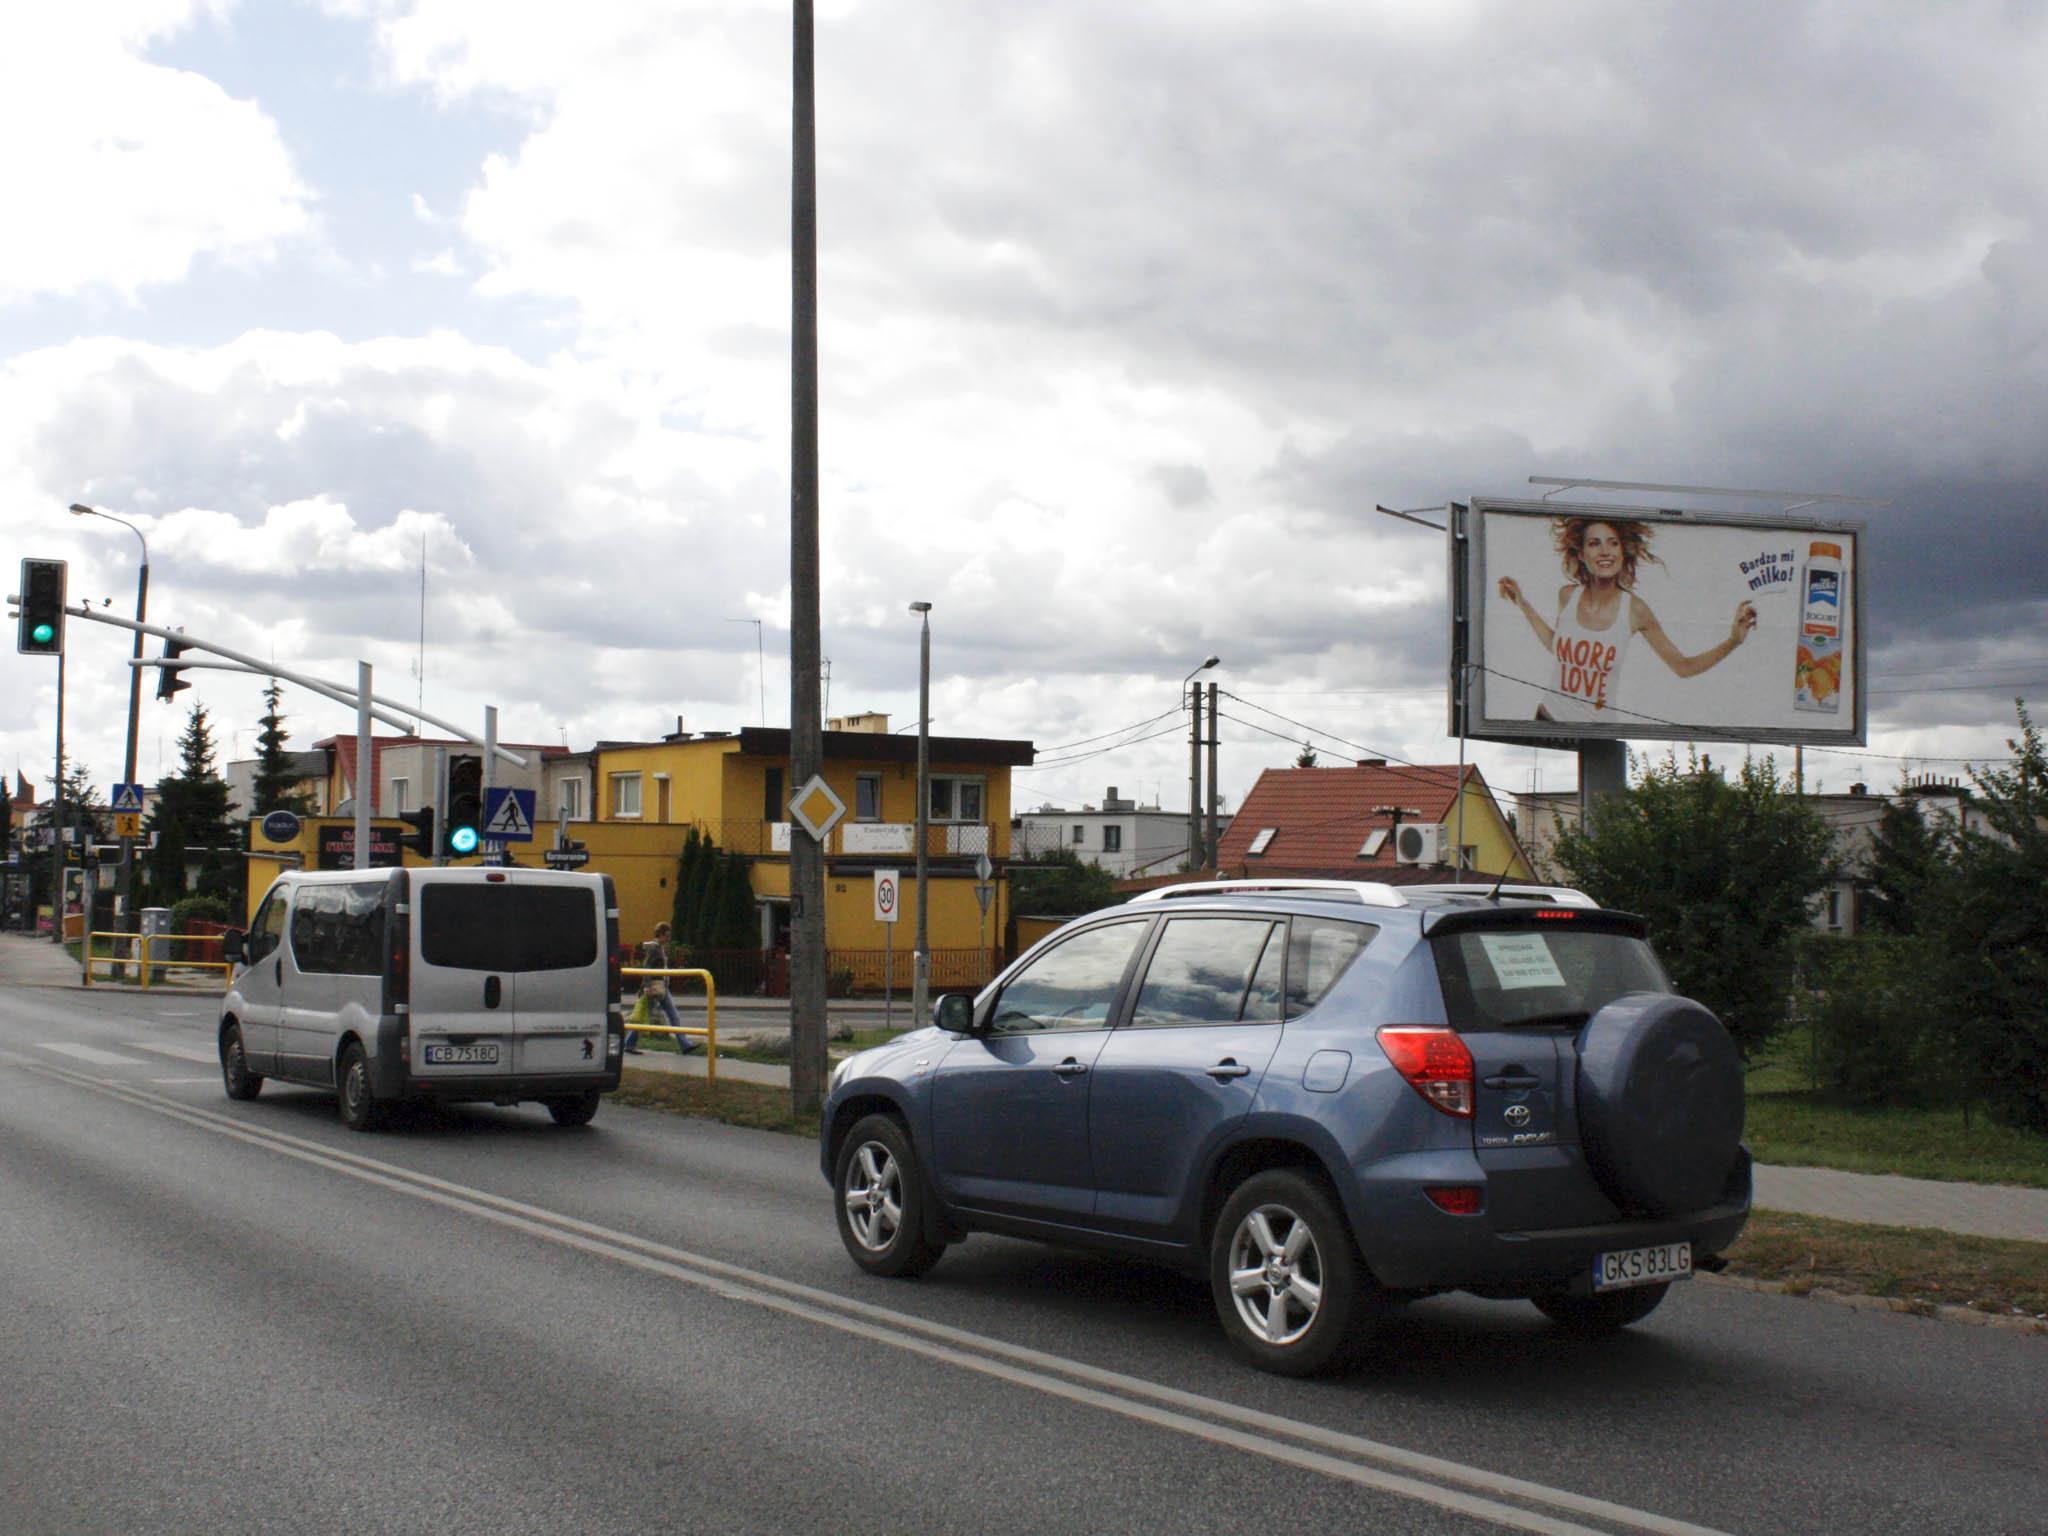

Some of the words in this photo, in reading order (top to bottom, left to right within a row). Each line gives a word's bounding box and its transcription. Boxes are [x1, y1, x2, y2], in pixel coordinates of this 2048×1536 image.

[1739, 552, 1777, 575] Bardzo
[1780, 550, 1794, 562] mi
[1748, 567, 1794, 591] milko!
[1561, 664, 1607, 700] LOVE
[880, 887, 892, 904] 30
[434, 1047, 453, 1061] CB
[1605, 1250, 1643, 1280] GKS
[1647, 1244, 1690, 1275] 83LG
